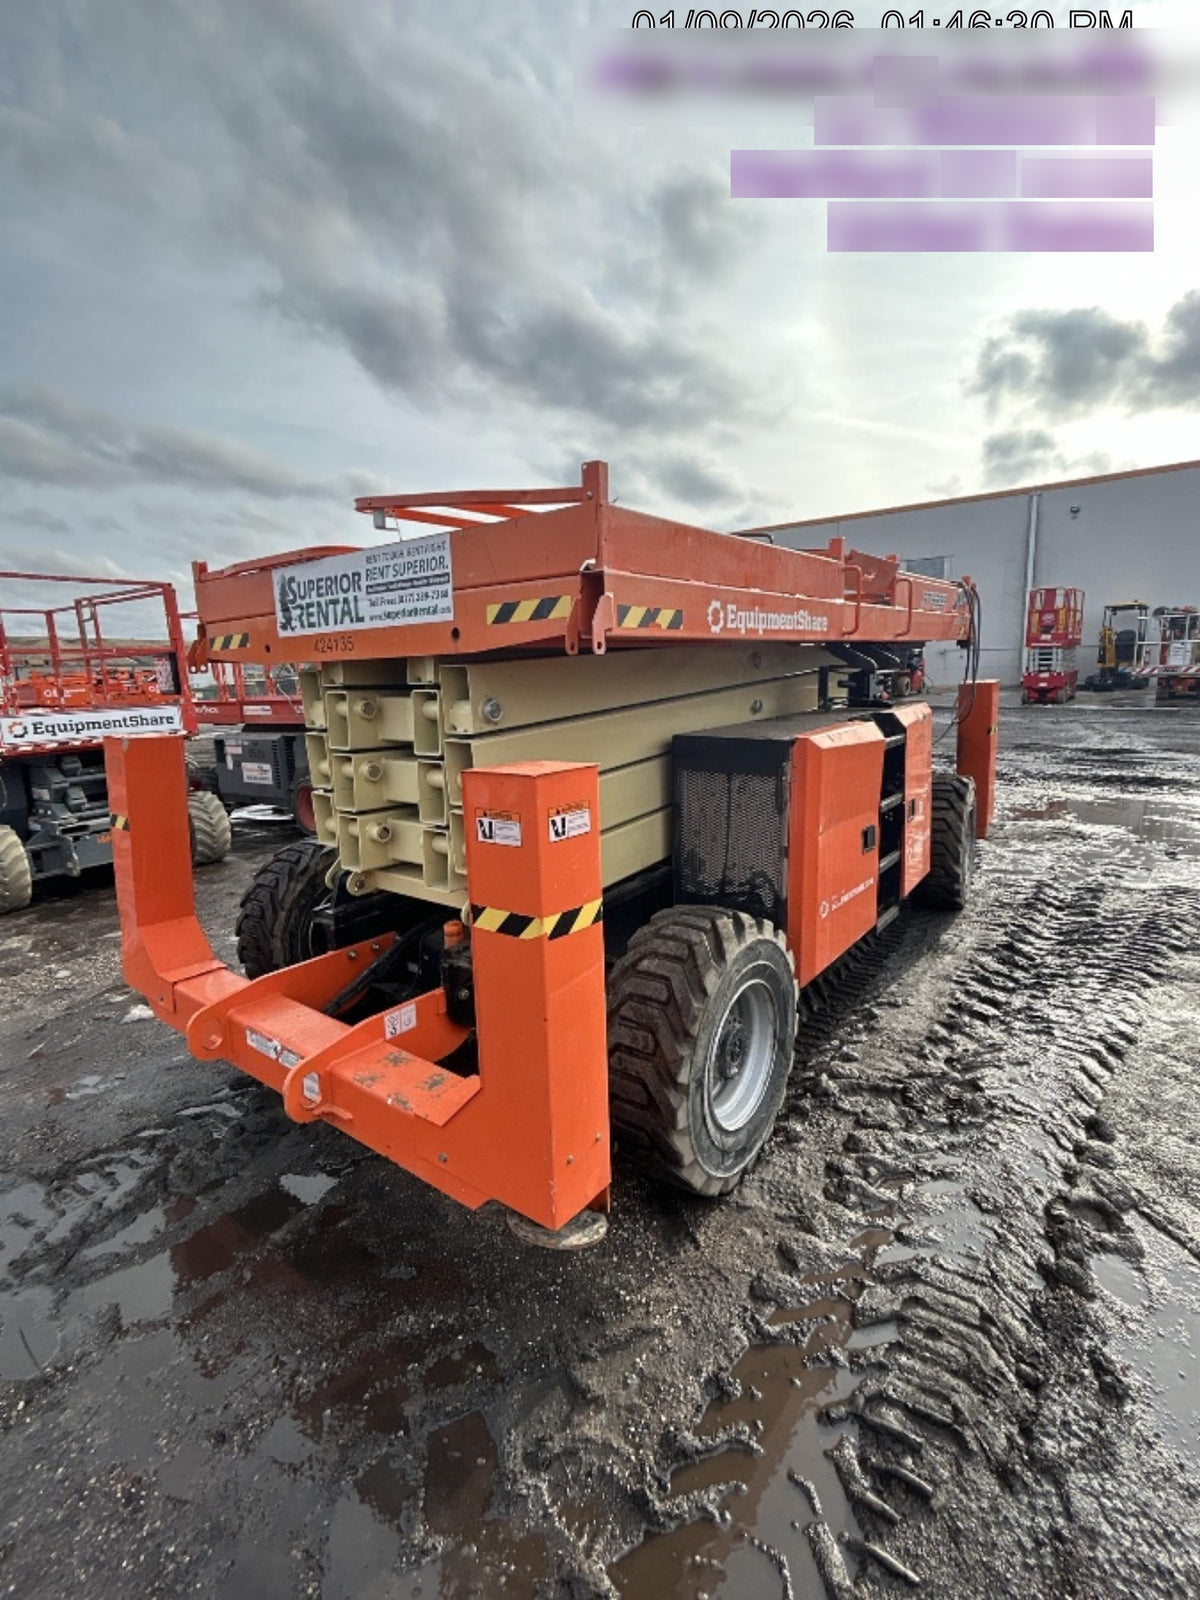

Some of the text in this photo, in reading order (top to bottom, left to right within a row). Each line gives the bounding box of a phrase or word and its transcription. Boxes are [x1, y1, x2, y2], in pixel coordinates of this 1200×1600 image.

[365, 555, 449, 582] RENT SUPERIOR.
[286, 572, 362, 605] SUPERIOR
[291, 595, 365, 629] RENTAL
[726, 604, 828, 635] EquipmentShare
[313, 636, 355, 653] 424135
[32, 715, 175, 737] EquipmentShare
